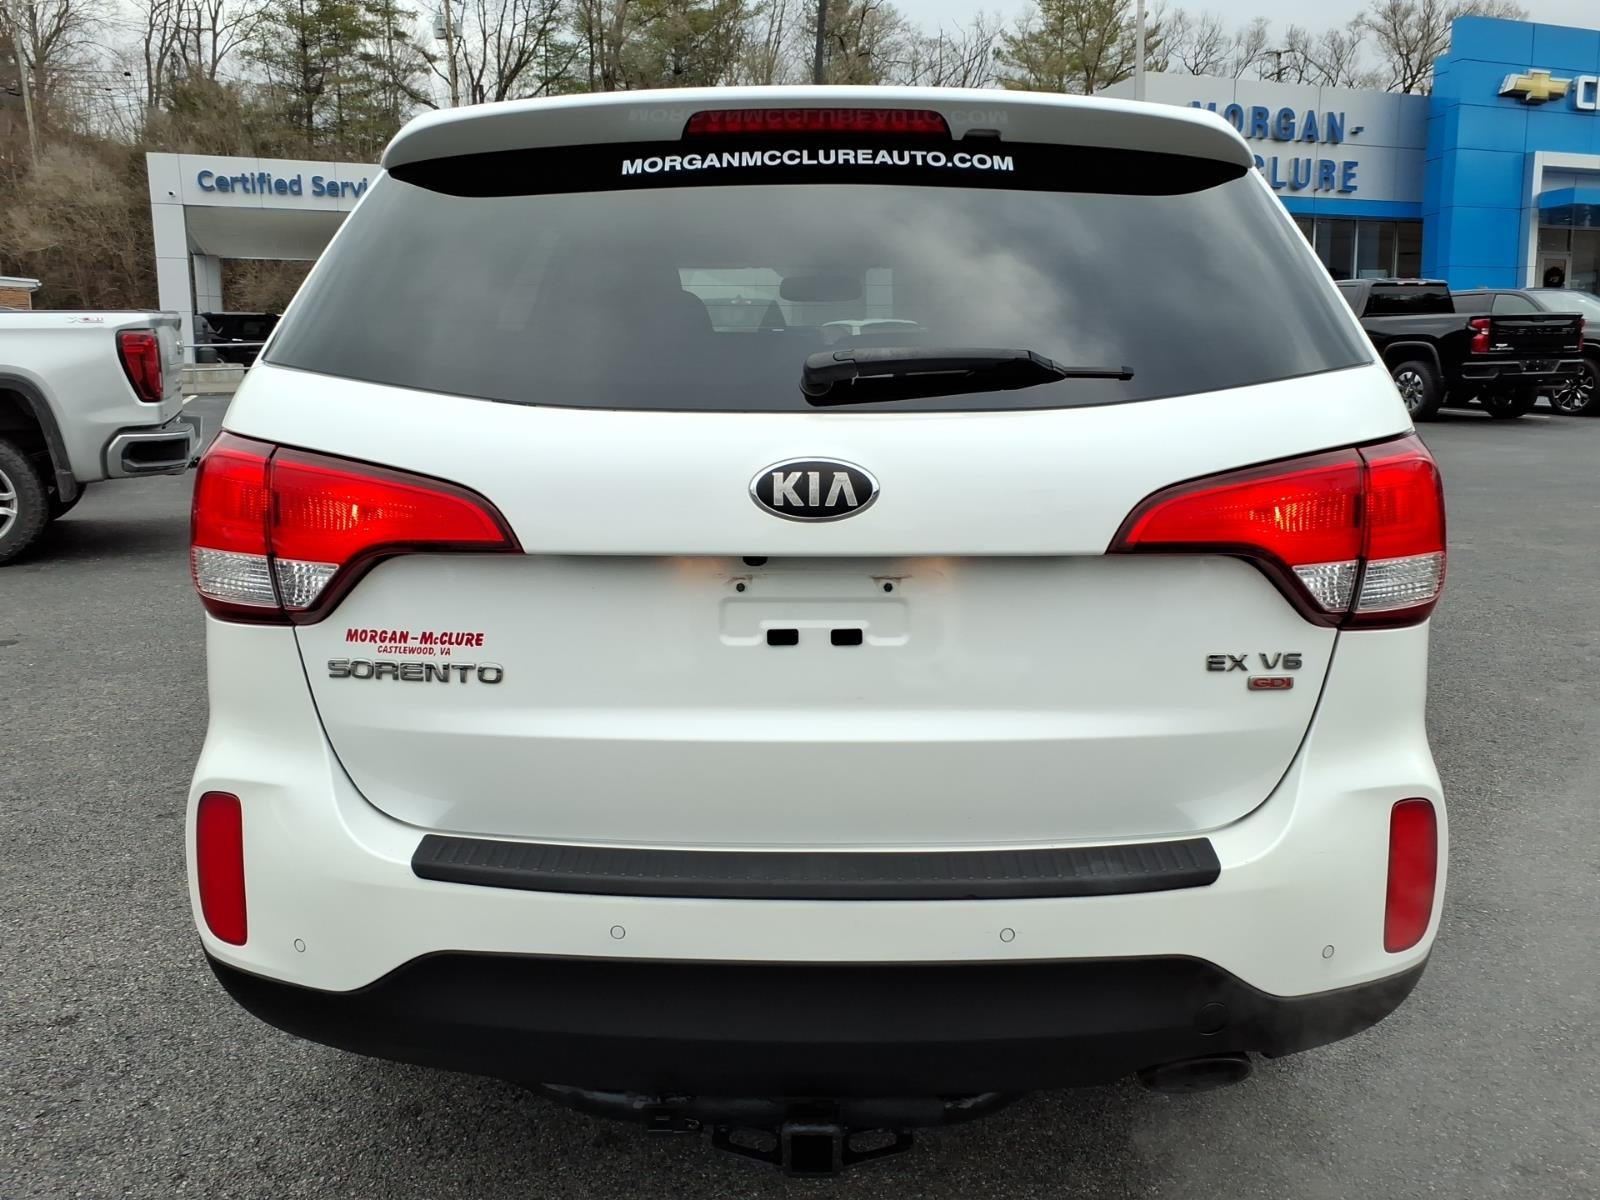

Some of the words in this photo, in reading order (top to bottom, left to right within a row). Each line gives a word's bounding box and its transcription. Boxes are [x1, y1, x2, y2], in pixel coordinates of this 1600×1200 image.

[1576, 75, 1600, 110] C
[1191, 101, 1364, 143] ORGAN-
[621, 150, 1014, 175] MORGANMCCLUREAUTO.COM
[197, 170, 303, 197] Certified
[312, 175, 367, 198] Servi
[772, 471, 858, 507] KIA
[377, 645, 436, 656] CASTLEWOOD,
[440, 648, 451, 656] VA
[1207, 654, 1248, 672] EX
[1259, 652, 1303, 670] V6
[327, 658, 504, 684] SORENTO
[1253, 677, 1292, 688] GDI
